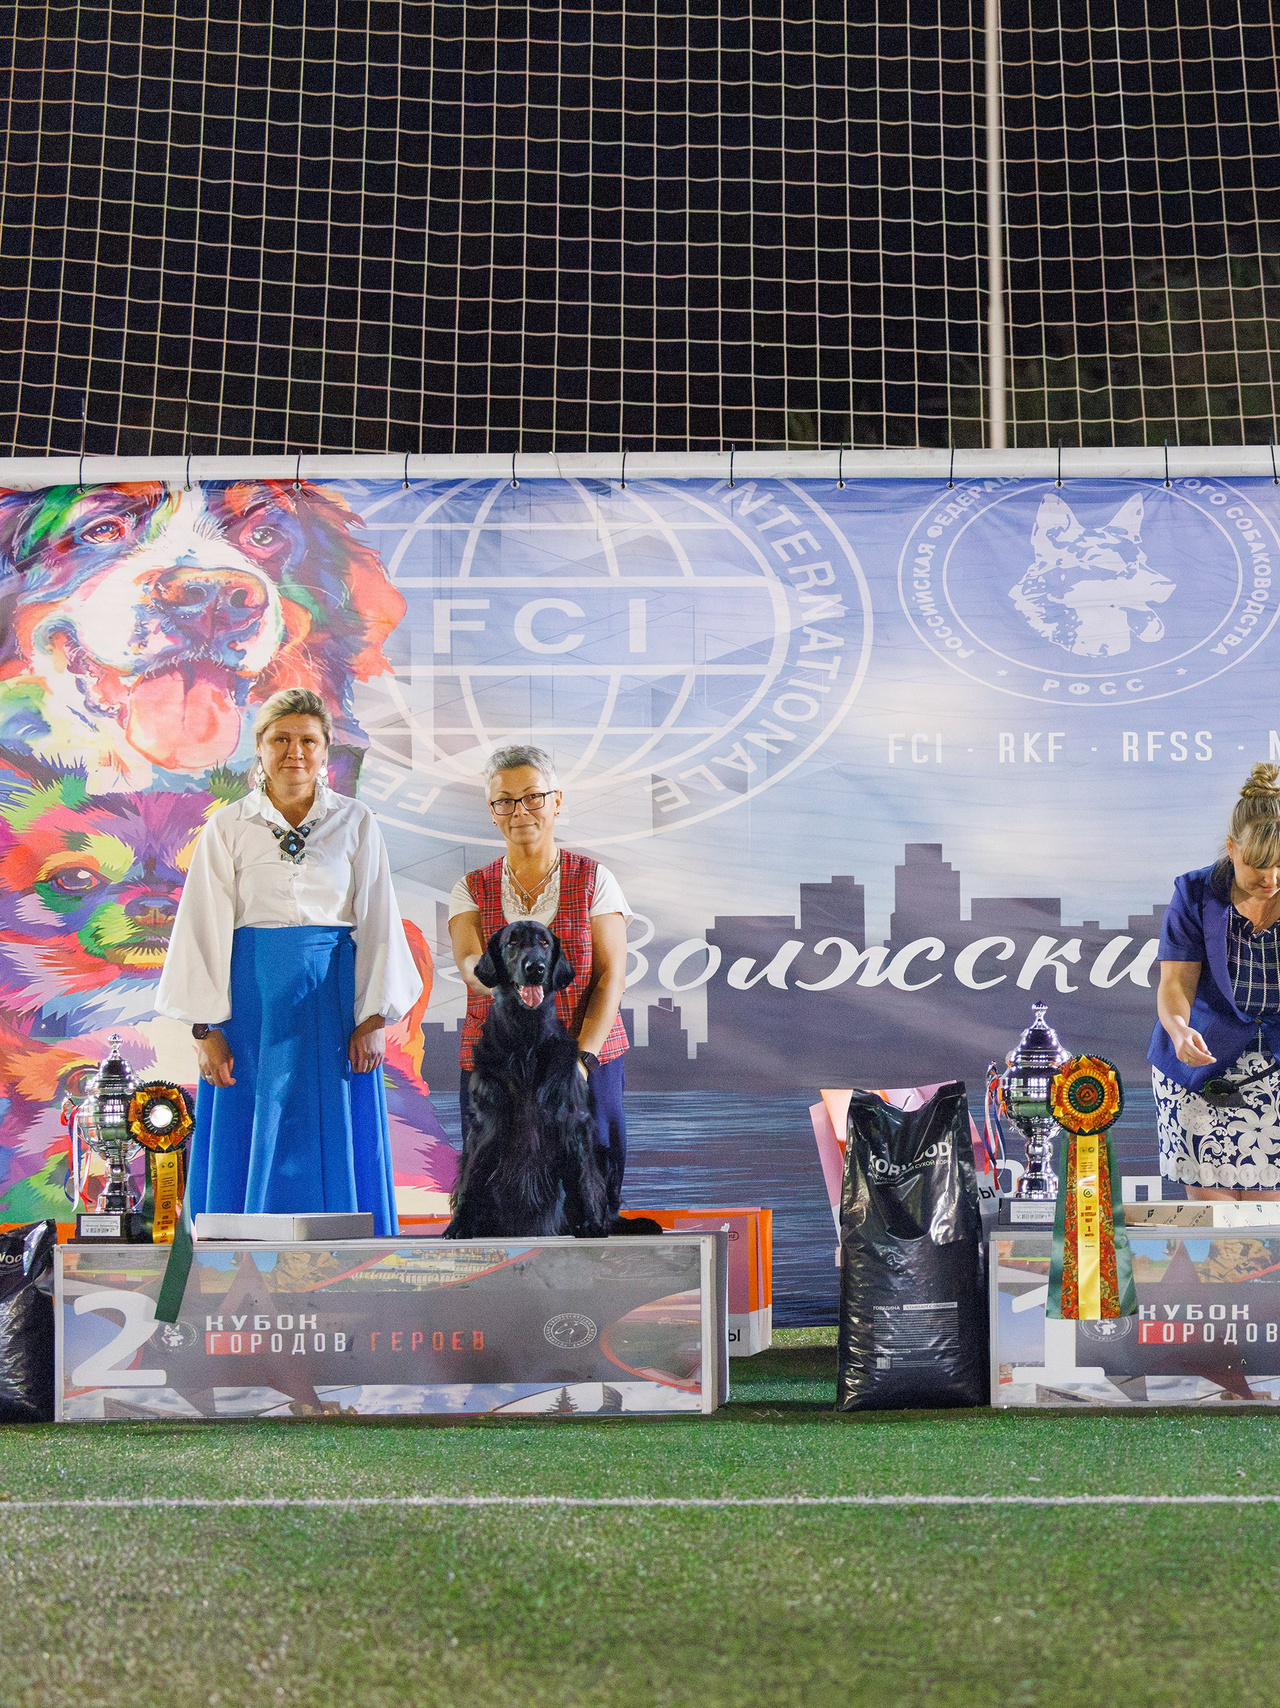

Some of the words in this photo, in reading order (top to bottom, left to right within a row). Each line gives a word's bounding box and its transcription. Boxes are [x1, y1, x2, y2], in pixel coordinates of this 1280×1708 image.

[433, 597, 649, 656] FCI
[643, 478, 847, 816] INTERNATIONALE
[1041, 677, 1146, 696] РФСС
[887, 732, 943, 764] FCI
[998, 731, 1066, 764] RKF
[1122, 730, 1214, 763] RFSS
[205, 1313, 317, 1331] КУБОК
[1138, 1303, 1251, 1321] КУБОК
[71, 1289, 168, 1387] 2
[209, 1332, 347, 1355] ГОРОДОВ
[370, 1330, 485, 1352] ГЕРОЕВ
[1141, 1322, 1279, 1345] ГОРОДОВ
